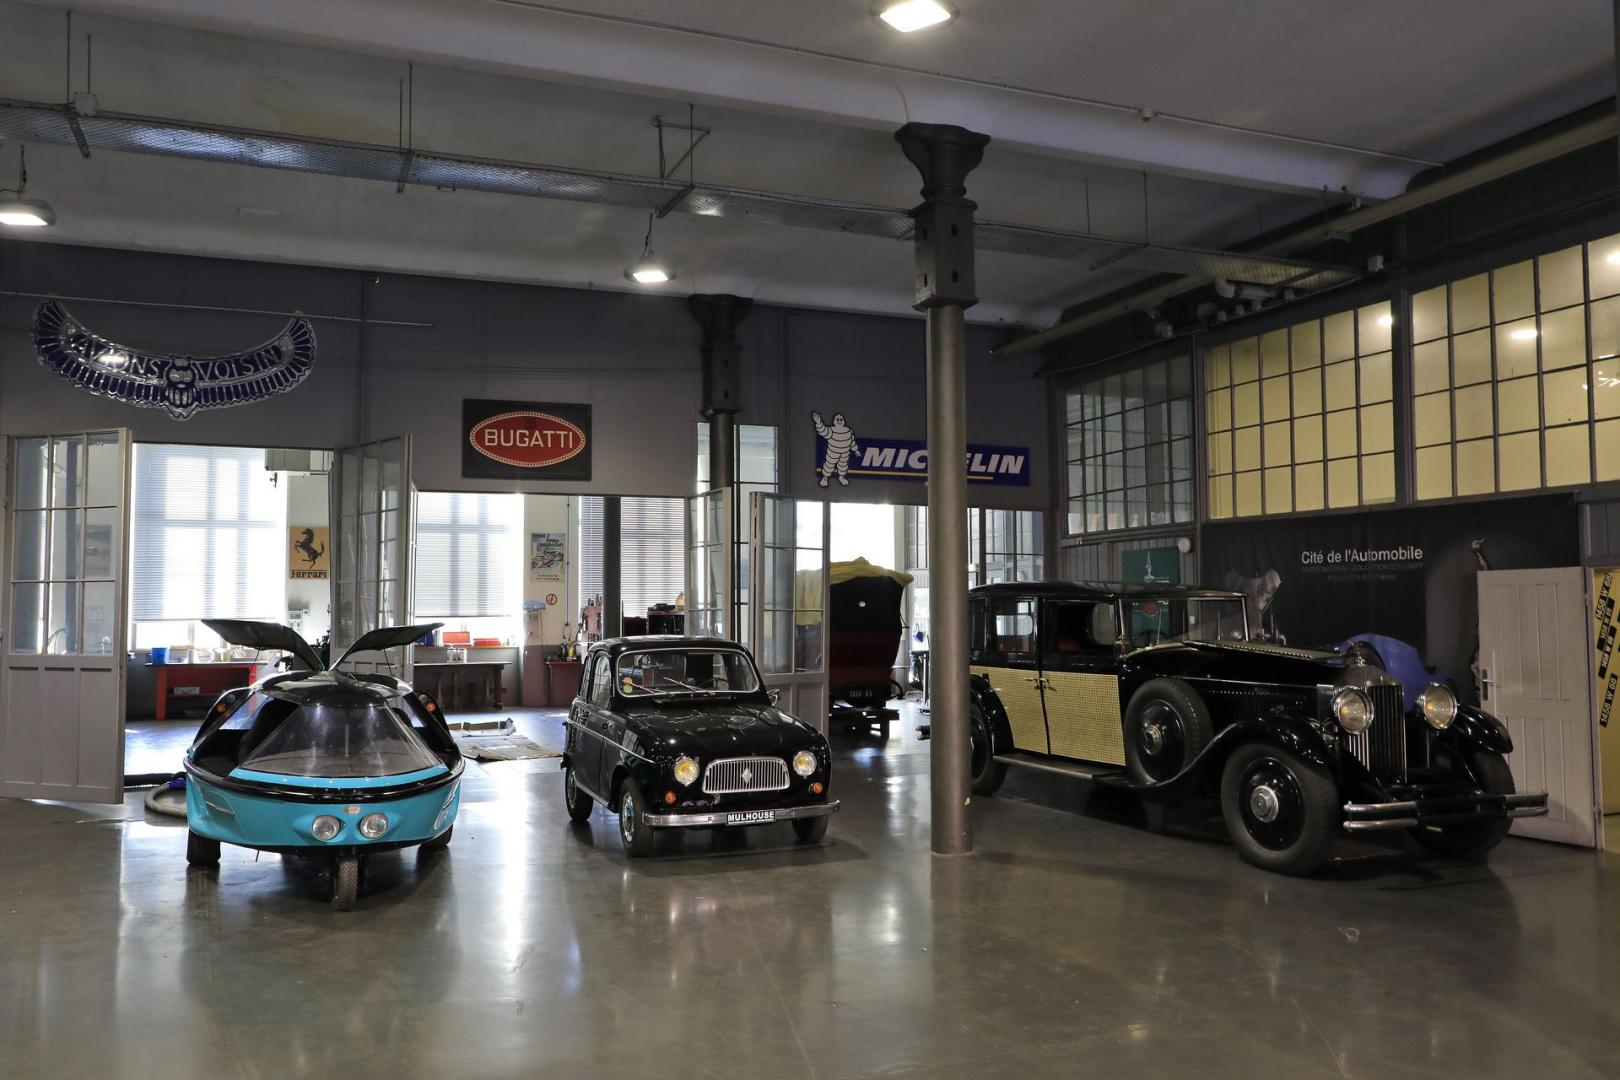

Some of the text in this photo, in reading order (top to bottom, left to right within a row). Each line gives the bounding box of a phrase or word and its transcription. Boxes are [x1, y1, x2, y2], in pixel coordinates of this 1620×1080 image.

[196, 342, 280, 381] VOISIN
[485, 429, 573, 448] BUGATTI
[861, 447, 1024, 474] MICLIN
[1302, 546, 1423, 564] Cité de l'Automobile
[1601, 679, 1617, 722] 1458 W 68
[727, 811, 775, 822] MULHOUSE
